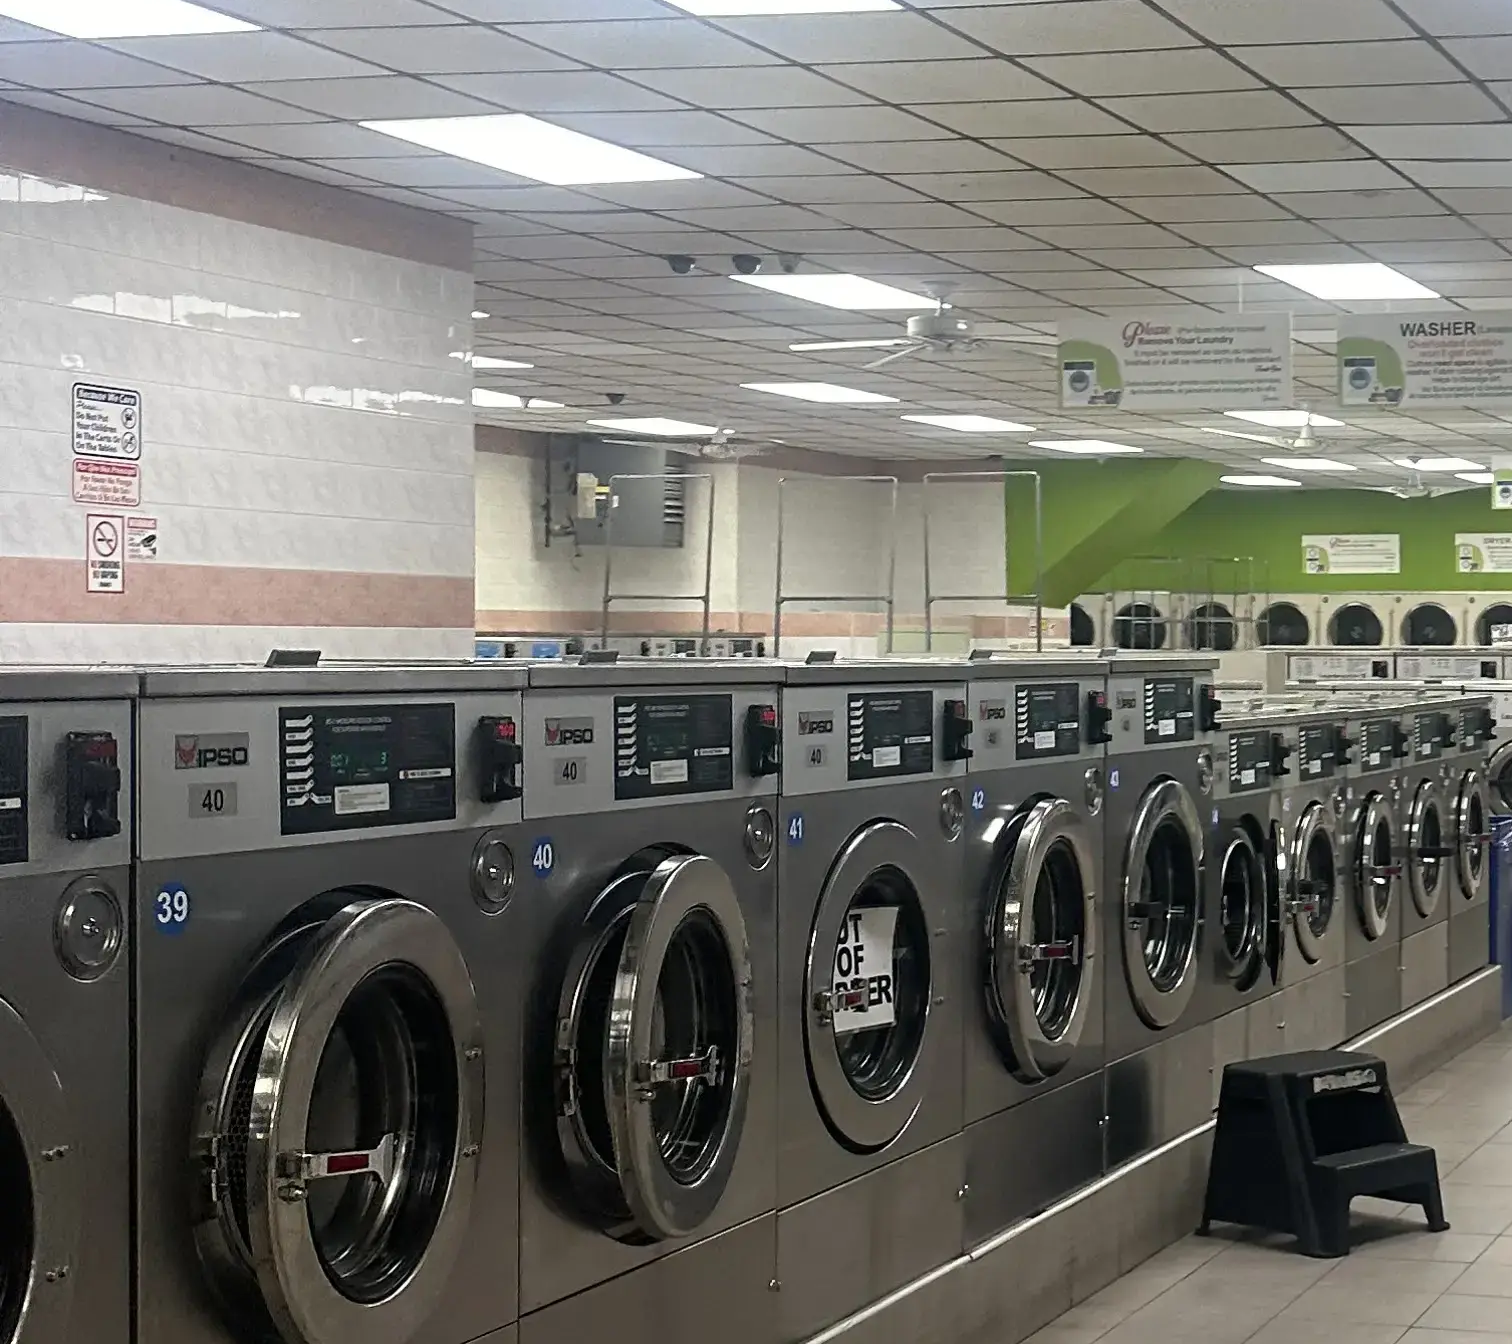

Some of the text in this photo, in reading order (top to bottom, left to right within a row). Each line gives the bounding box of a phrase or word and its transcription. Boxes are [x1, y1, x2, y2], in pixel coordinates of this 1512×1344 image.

[1400, 321, 1476, 337] WASHER
[1197, 336, 1233, 344] Laundry
[559, 729, 594, 745] IPSO
[197, 747, 249, 769] IPSO
[810, 748, 822, 765] 40
[562, 761, 578, 781] 40
[201, 789, 225, 813] 40
[971, 790, 985, 810] 42
[788, 816, 803, 839] 41
[532, 843, 553, 870] 40
[156, 890, 189, 924] 39
[836, 944, 865, 978] OF
